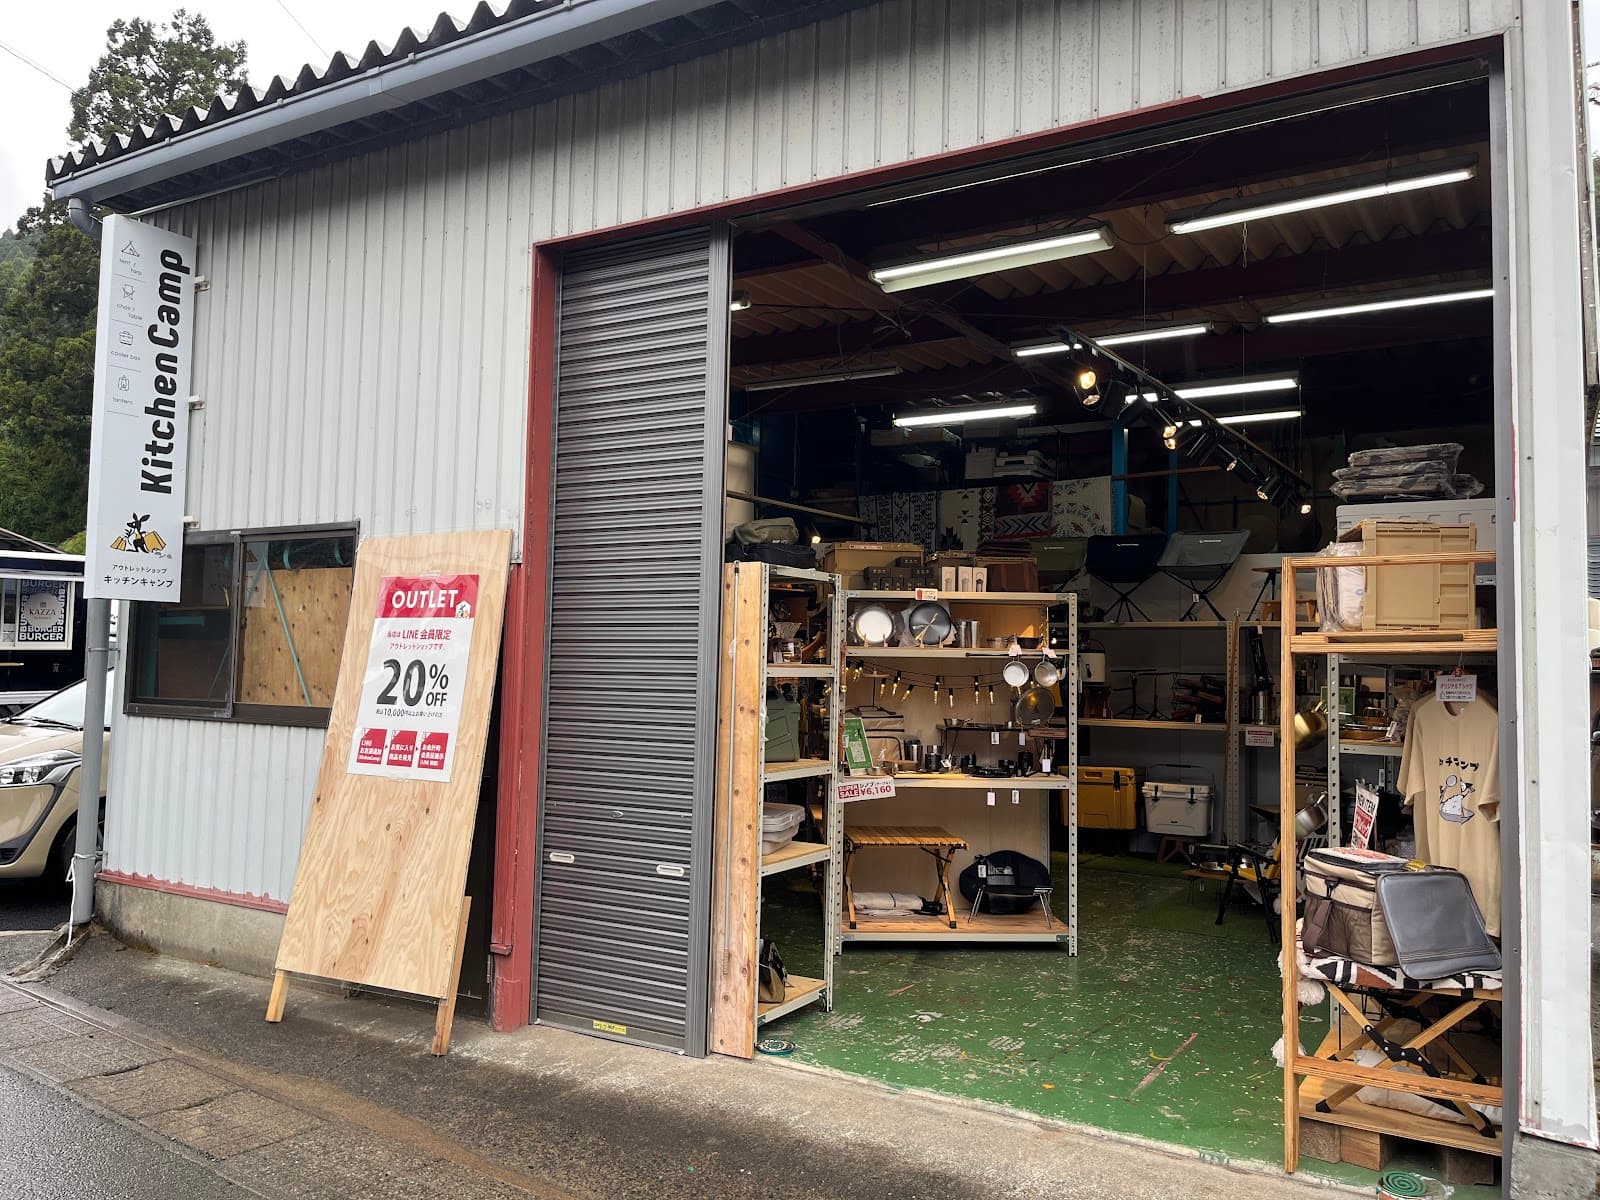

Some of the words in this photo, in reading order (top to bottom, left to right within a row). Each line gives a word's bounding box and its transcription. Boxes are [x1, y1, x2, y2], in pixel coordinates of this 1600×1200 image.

[141, 249, 190, 494] KitchenCamp
[112, 564, 167, 574] アウトレットショップ
[103, 575, 174, 588] キッチンキャンプ
[391, 589, 458, 609] OUTLET
[20, 632, 64, 641] BURGER
[402, 629, 419, 639] LINE
[425, 692, 447, 707] OFF
[839, 789, 860, 799] SALE
[860, 785, 892, 796] ¥6,160
